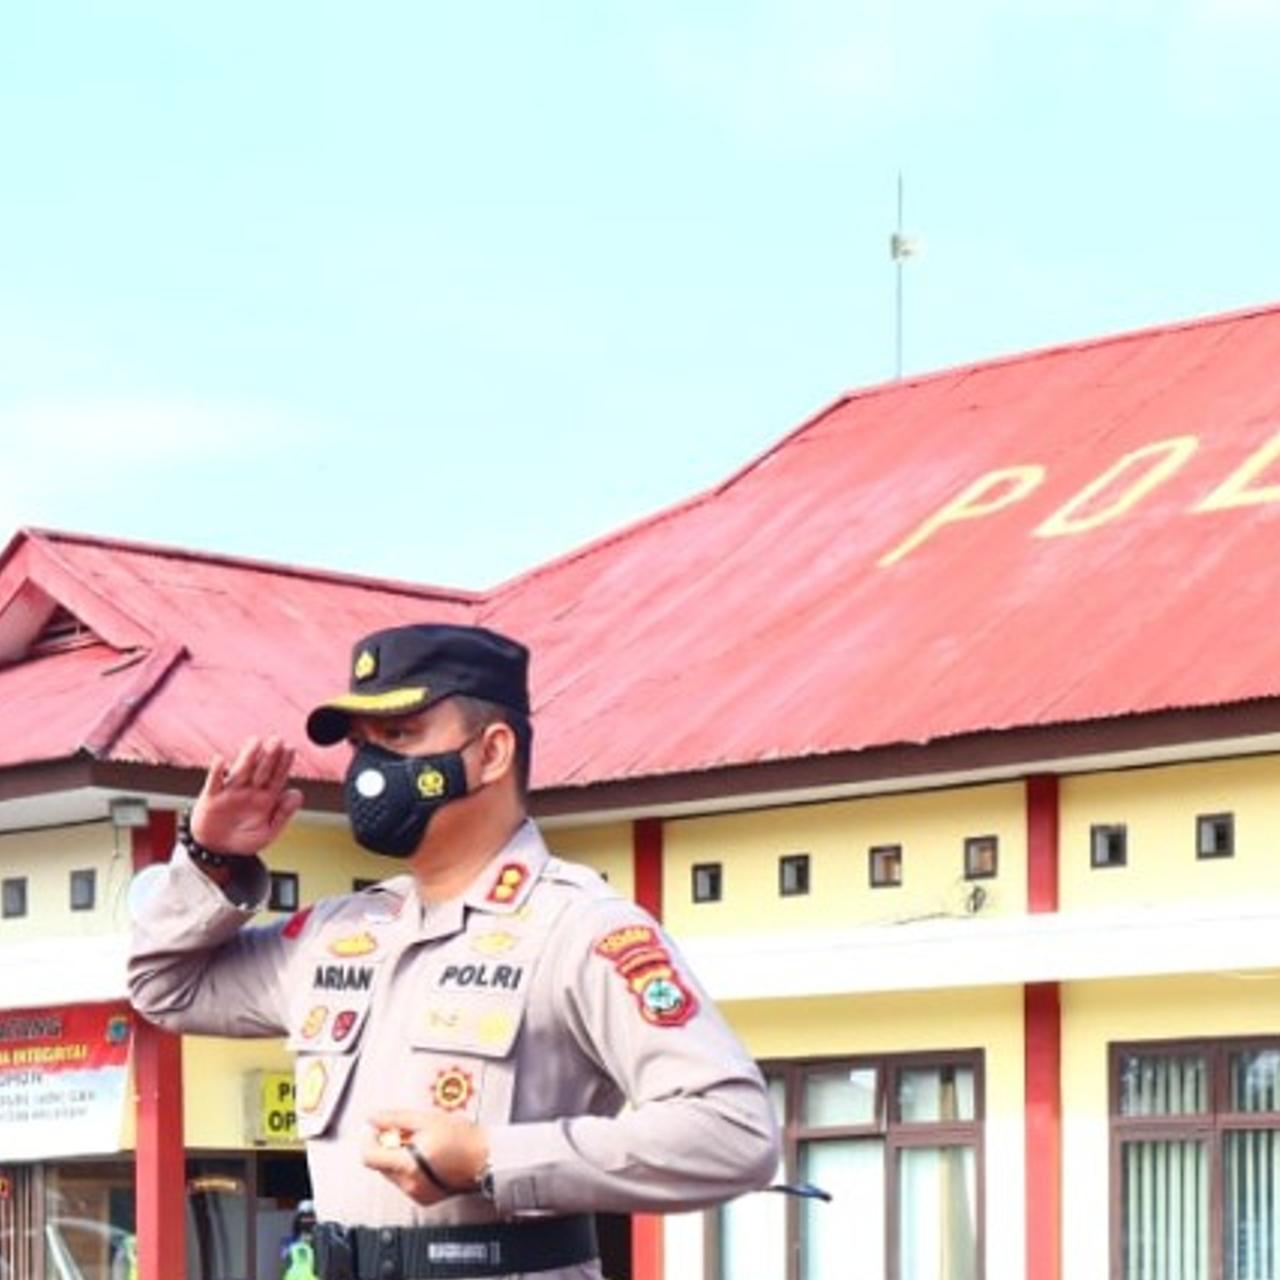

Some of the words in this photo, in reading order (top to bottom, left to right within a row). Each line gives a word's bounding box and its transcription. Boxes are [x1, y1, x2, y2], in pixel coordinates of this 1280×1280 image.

[312, 964, 375, 991] ARIAN
[438, 963, 523, 991] POLRI
[278, 1082, 296, 1101] P
